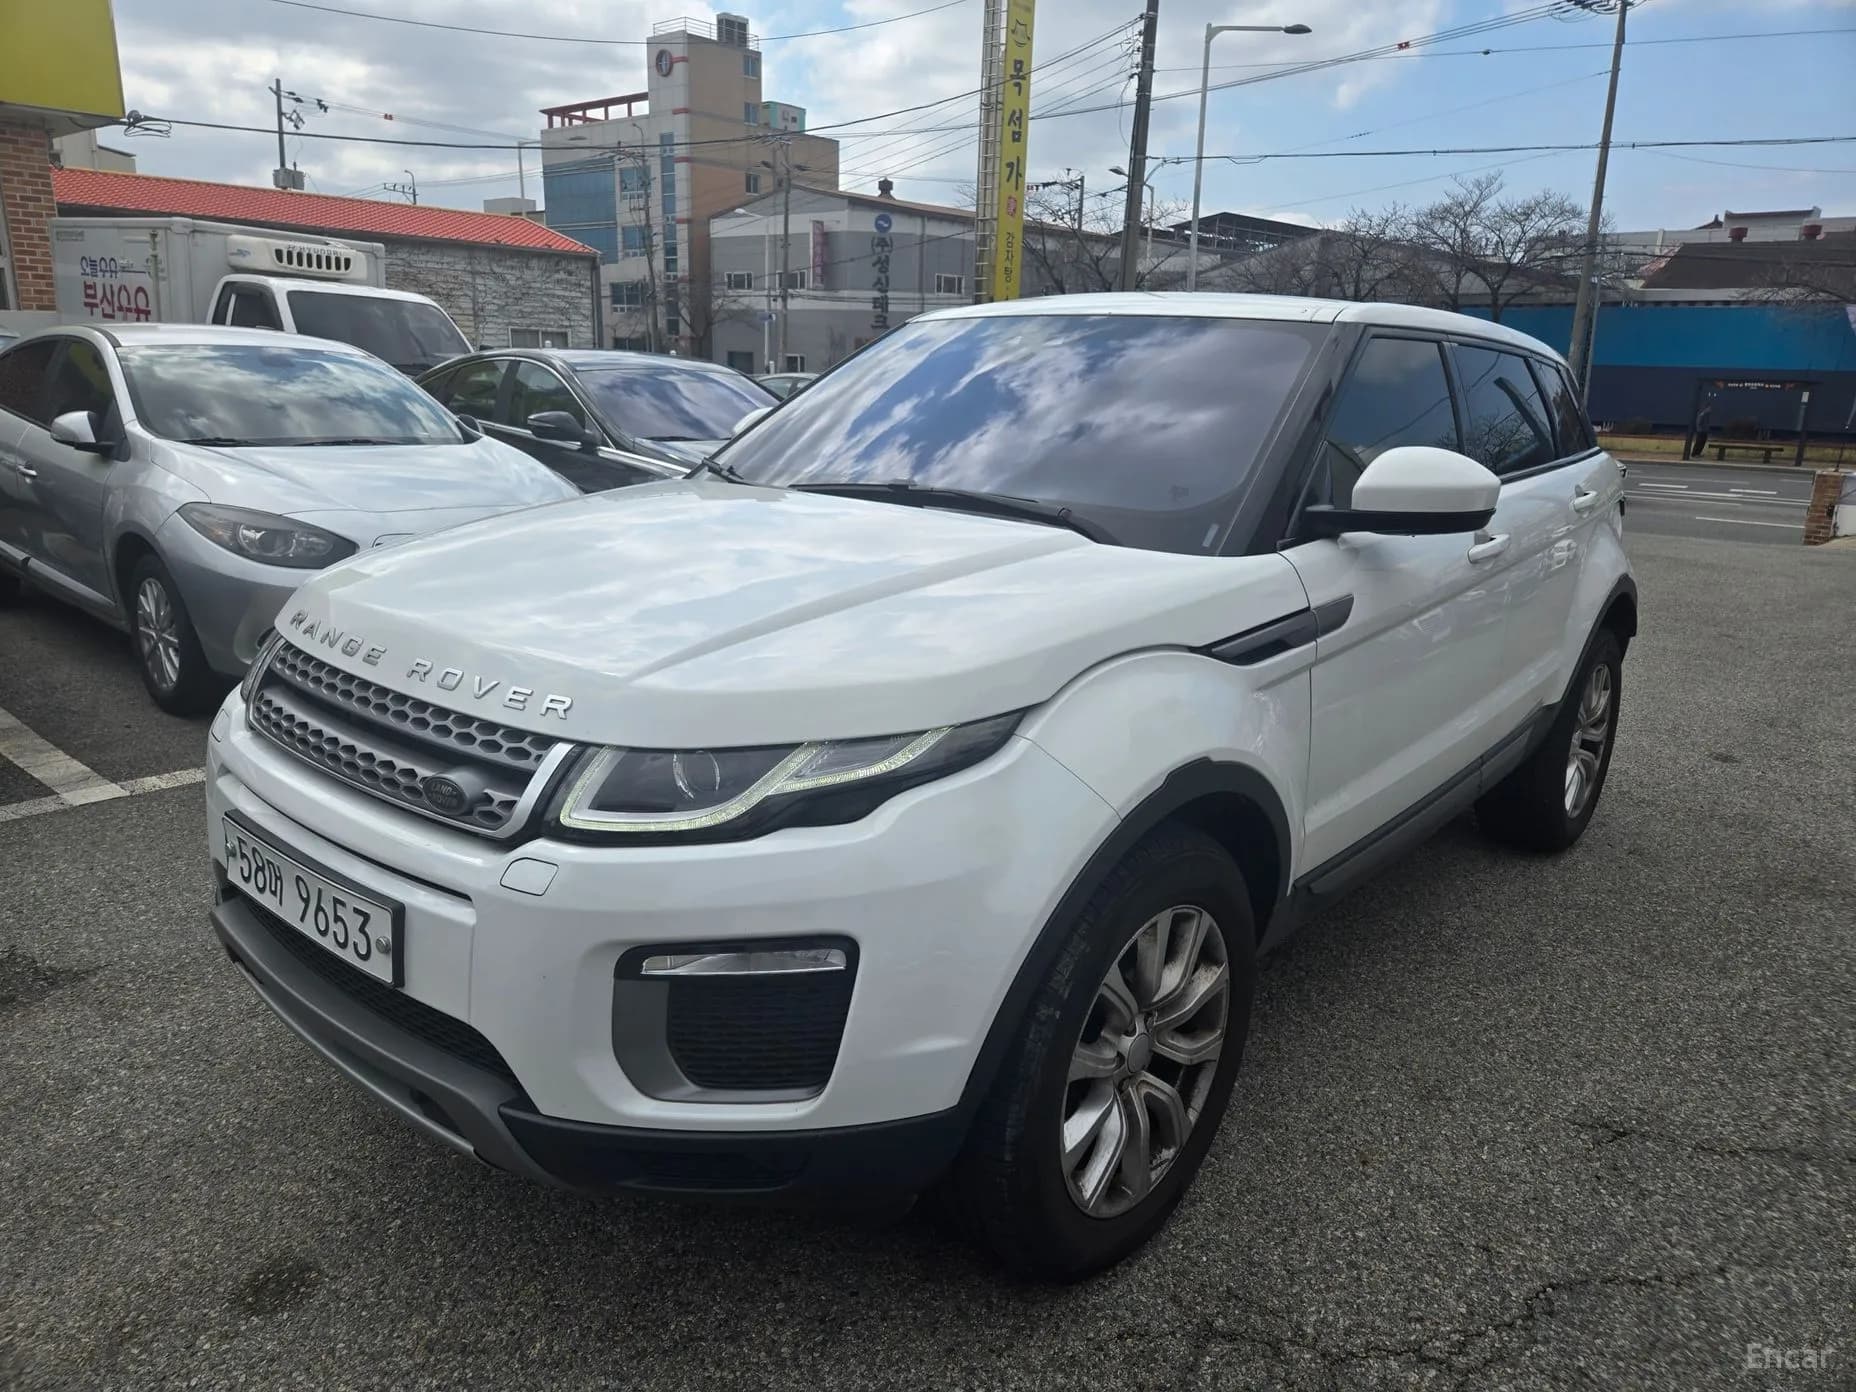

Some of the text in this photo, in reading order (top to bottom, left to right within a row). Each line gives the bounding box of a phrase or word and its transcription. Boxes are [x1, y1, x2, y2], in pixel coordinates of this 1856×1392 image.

[83, 281, 151, 322] 부산우유
[290, 609, 573, 720] RANGE ROVER
[236, 836, 372, 962] 58머 9653
